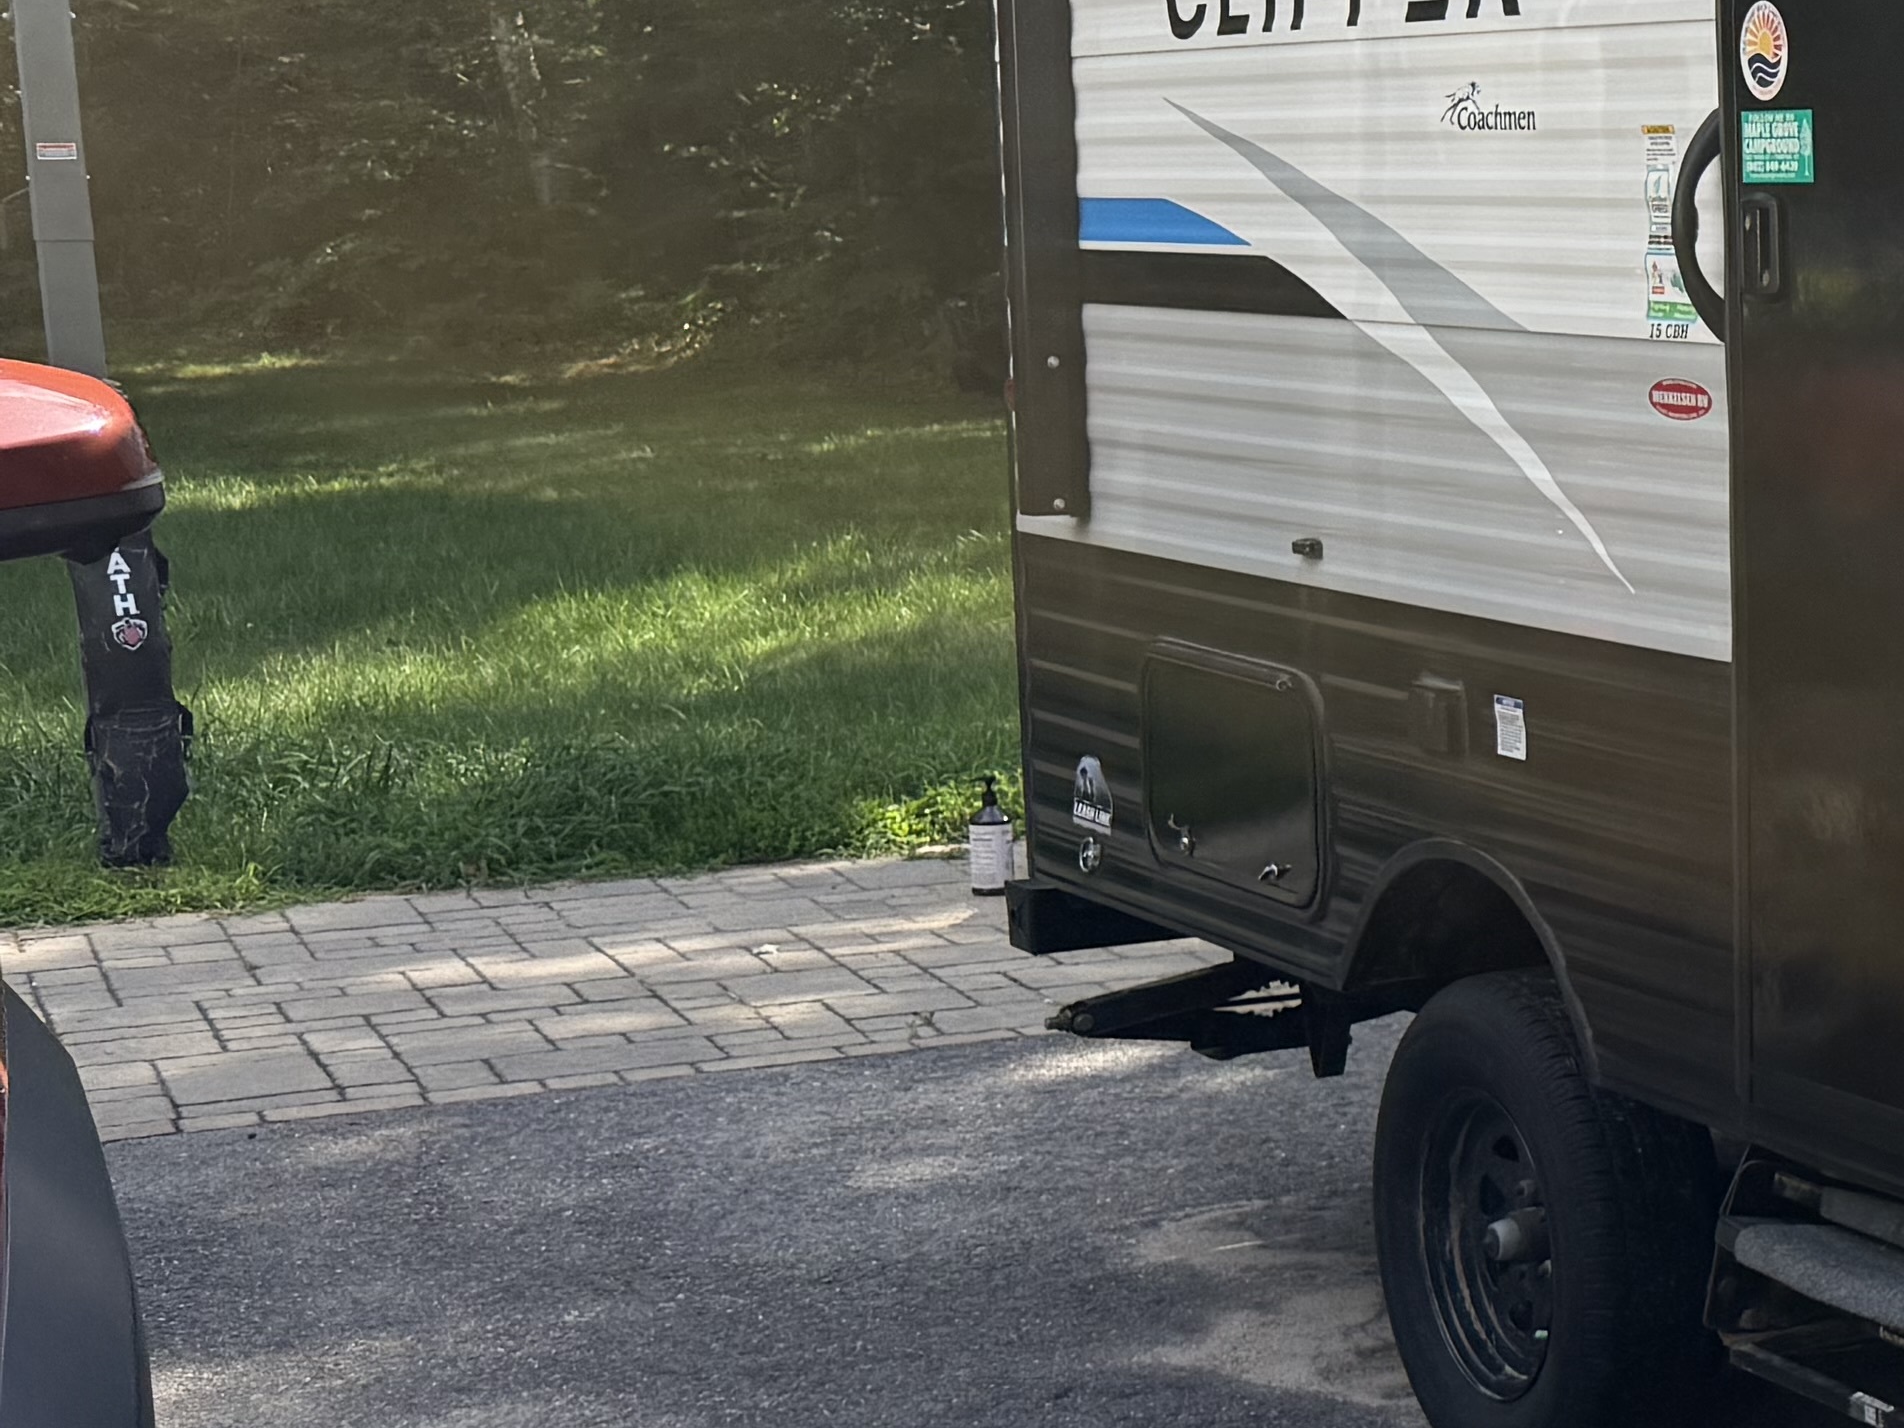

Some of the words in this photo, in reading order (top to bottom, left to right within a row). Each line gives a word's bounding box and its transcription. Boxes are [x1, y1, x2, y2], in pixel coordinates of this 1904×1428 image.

[1457, 102, 1537, 133] Coachmen
[1743, 122, 1771, 138] MAPLE
[1771, 121, 1799, 138] GROVE
[1743, 138, 1800, 154] CAMPGROUND
[1649, 323, 1662, 339] 15
[1665, 323, 1689, 340] CBH
[106, 546, 141, 617] ATH
